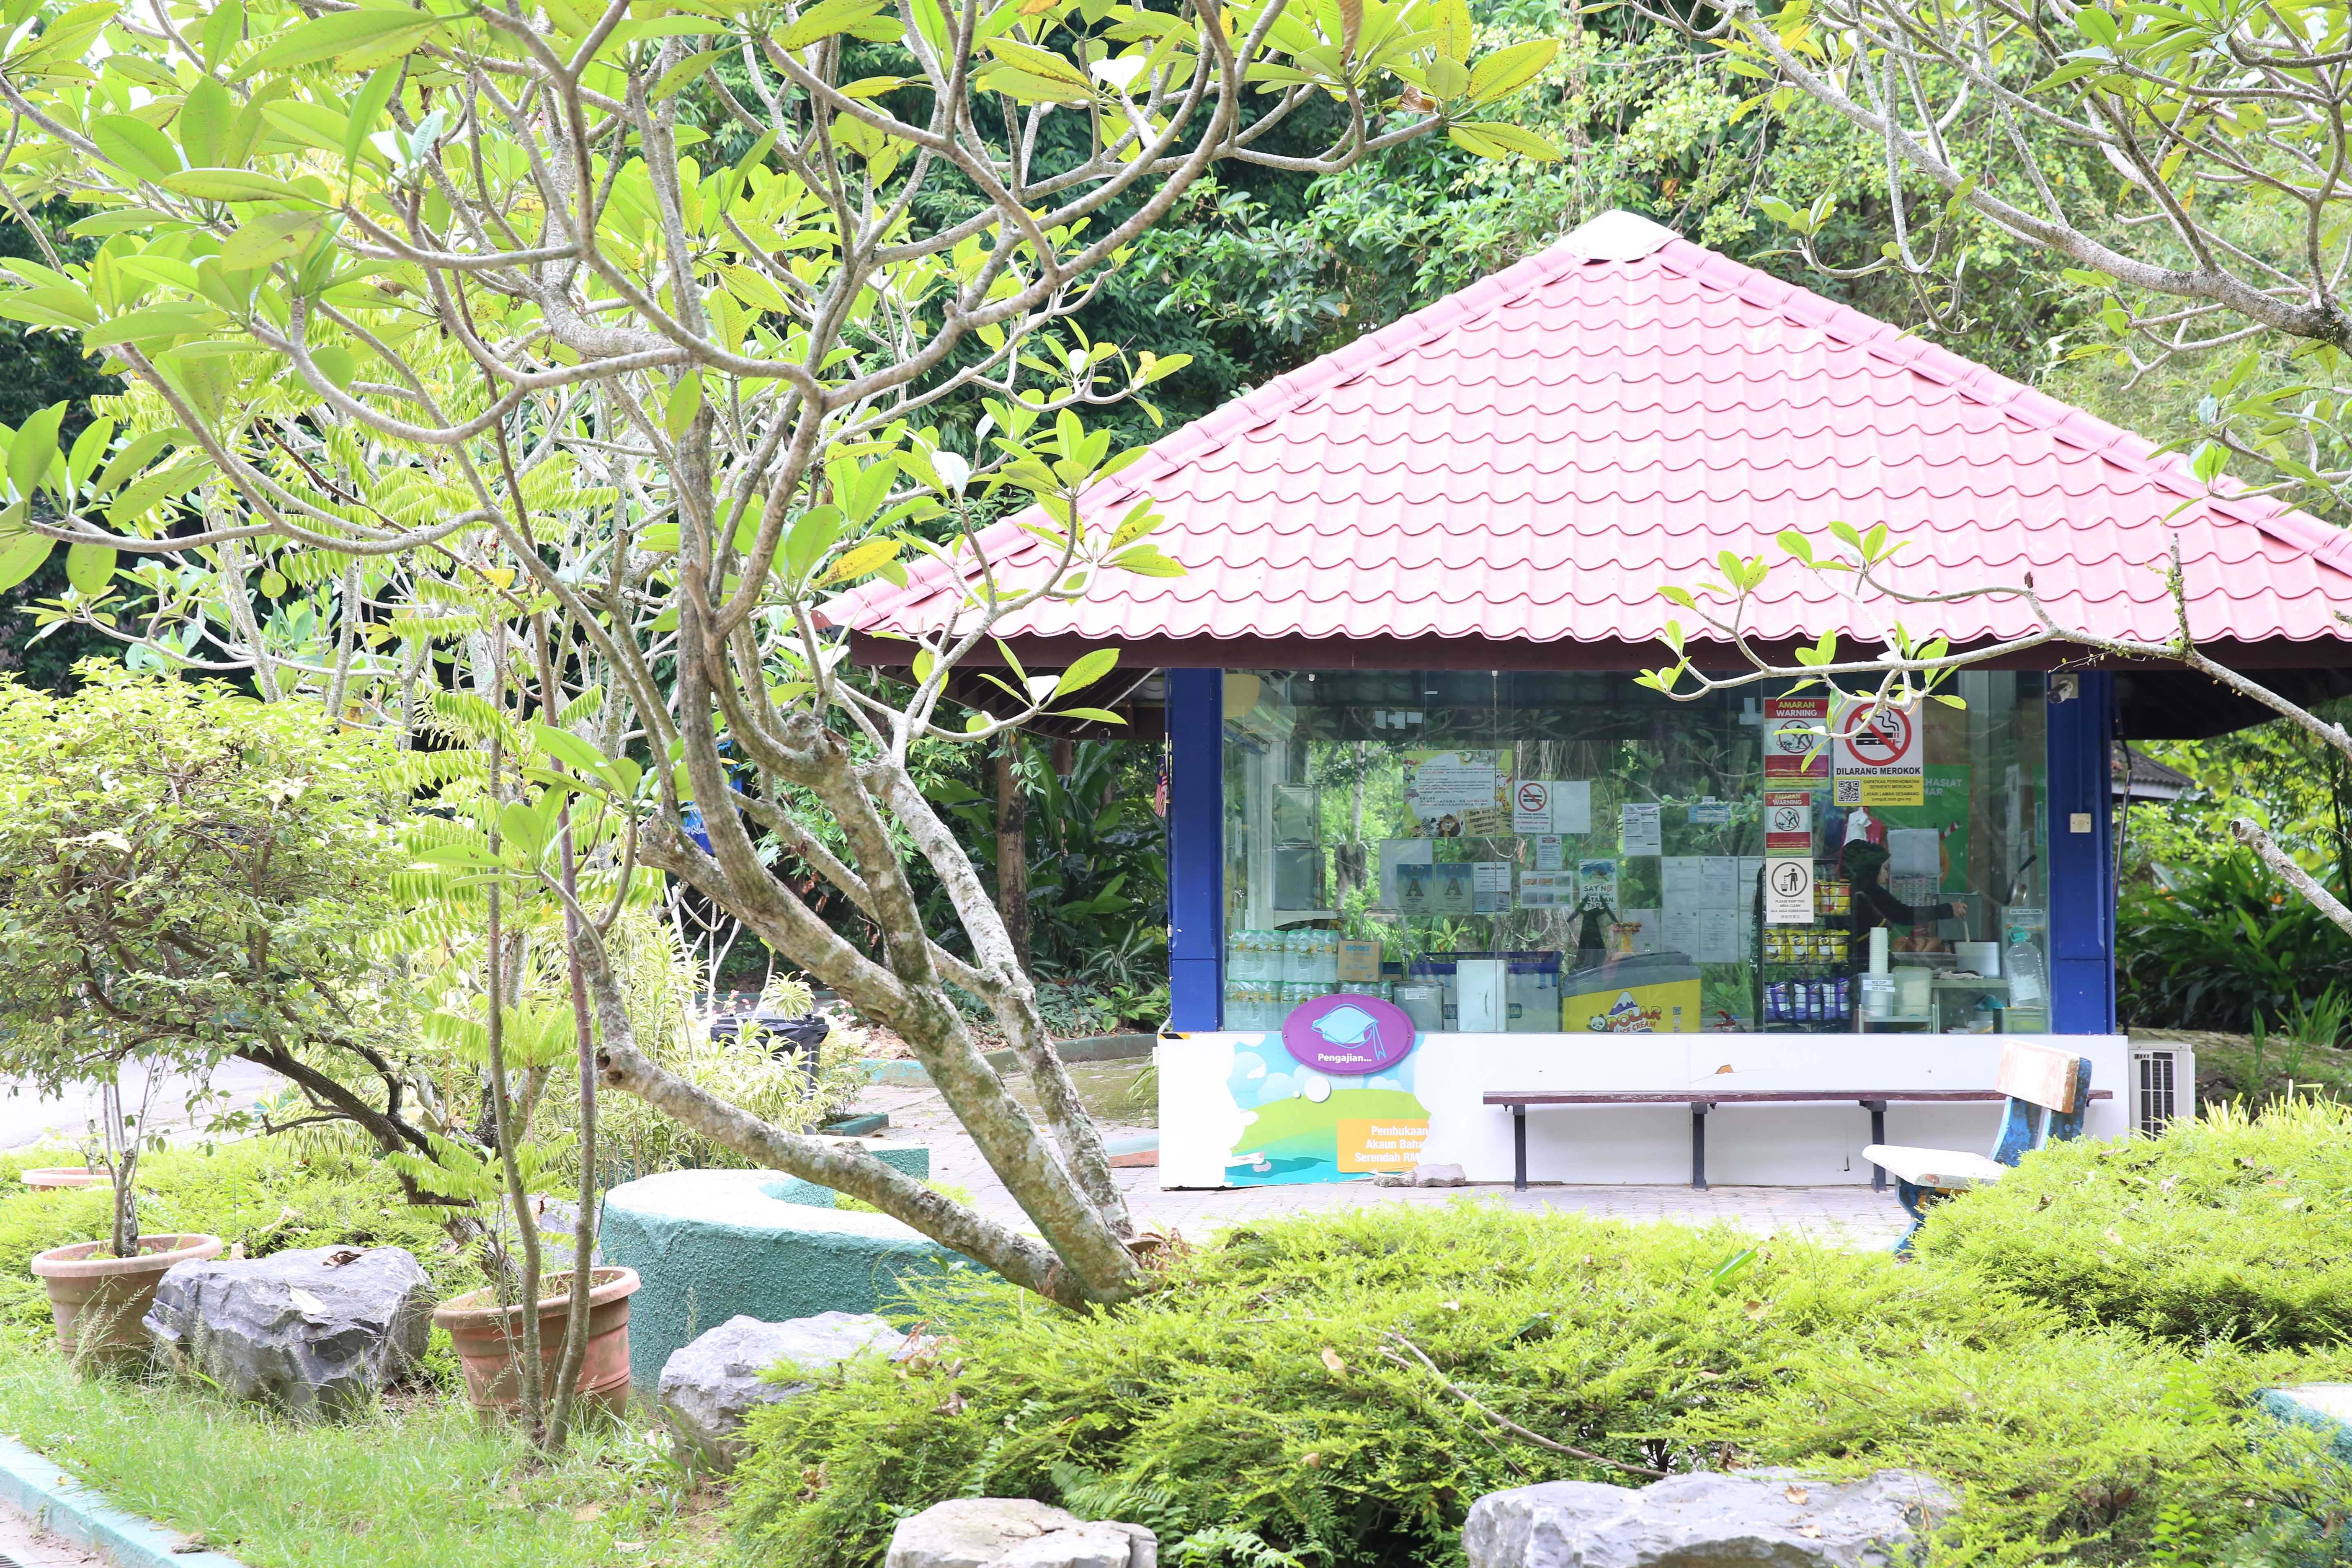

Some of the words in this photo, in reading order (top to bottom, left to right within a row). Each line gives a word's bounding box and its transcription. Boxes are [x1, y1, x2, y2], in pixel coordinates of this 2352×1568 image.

[1923, 778, 1962, 787] HASIAT
[1606, 1006, 1662, 1032] POLAR
[1632, 1021, 1656, 1031] CREAM
[1318, 1053, 1372, 1064] Pengajian...
[1371, 1126, 1428, 1136] Pembukaan
[1365, 1139, 1396, 1149] Akaun
[1355, 1152, 1401, 1162] Serendah
